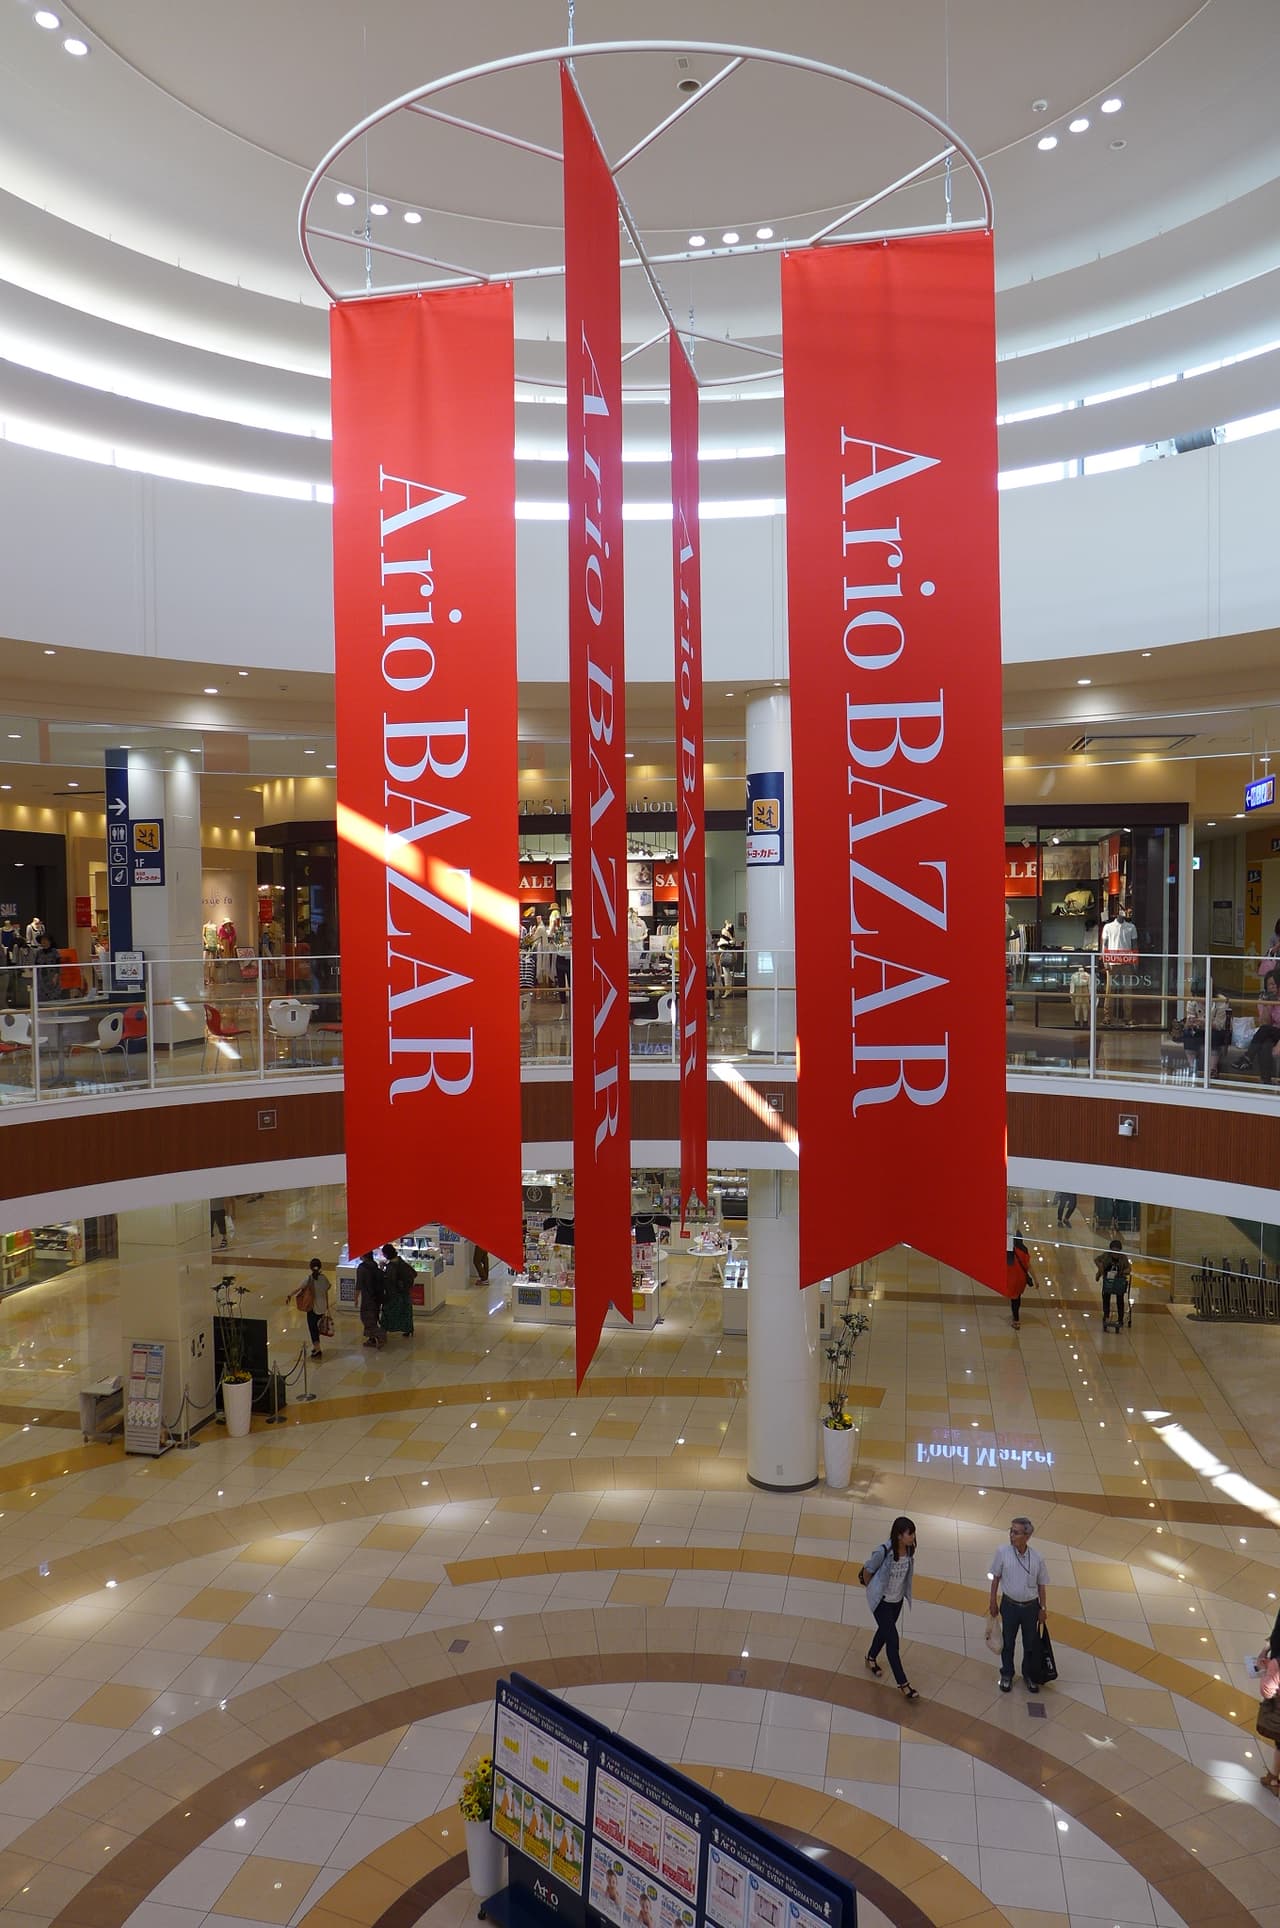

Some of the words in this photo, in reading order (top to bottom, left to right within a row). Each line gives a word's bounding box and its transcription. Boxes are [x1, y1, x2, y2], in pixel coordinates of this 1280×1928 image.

[134, 858, 145, 868] 1F
[518, 875, 553, 889] ALE
[655, 873, 678, 888] SA
[1110, 974, 1153, 987] KID'S
[767, 1870, 785, 1888] EVENT
[785, 1882, 823, 1913] INFORMATION
